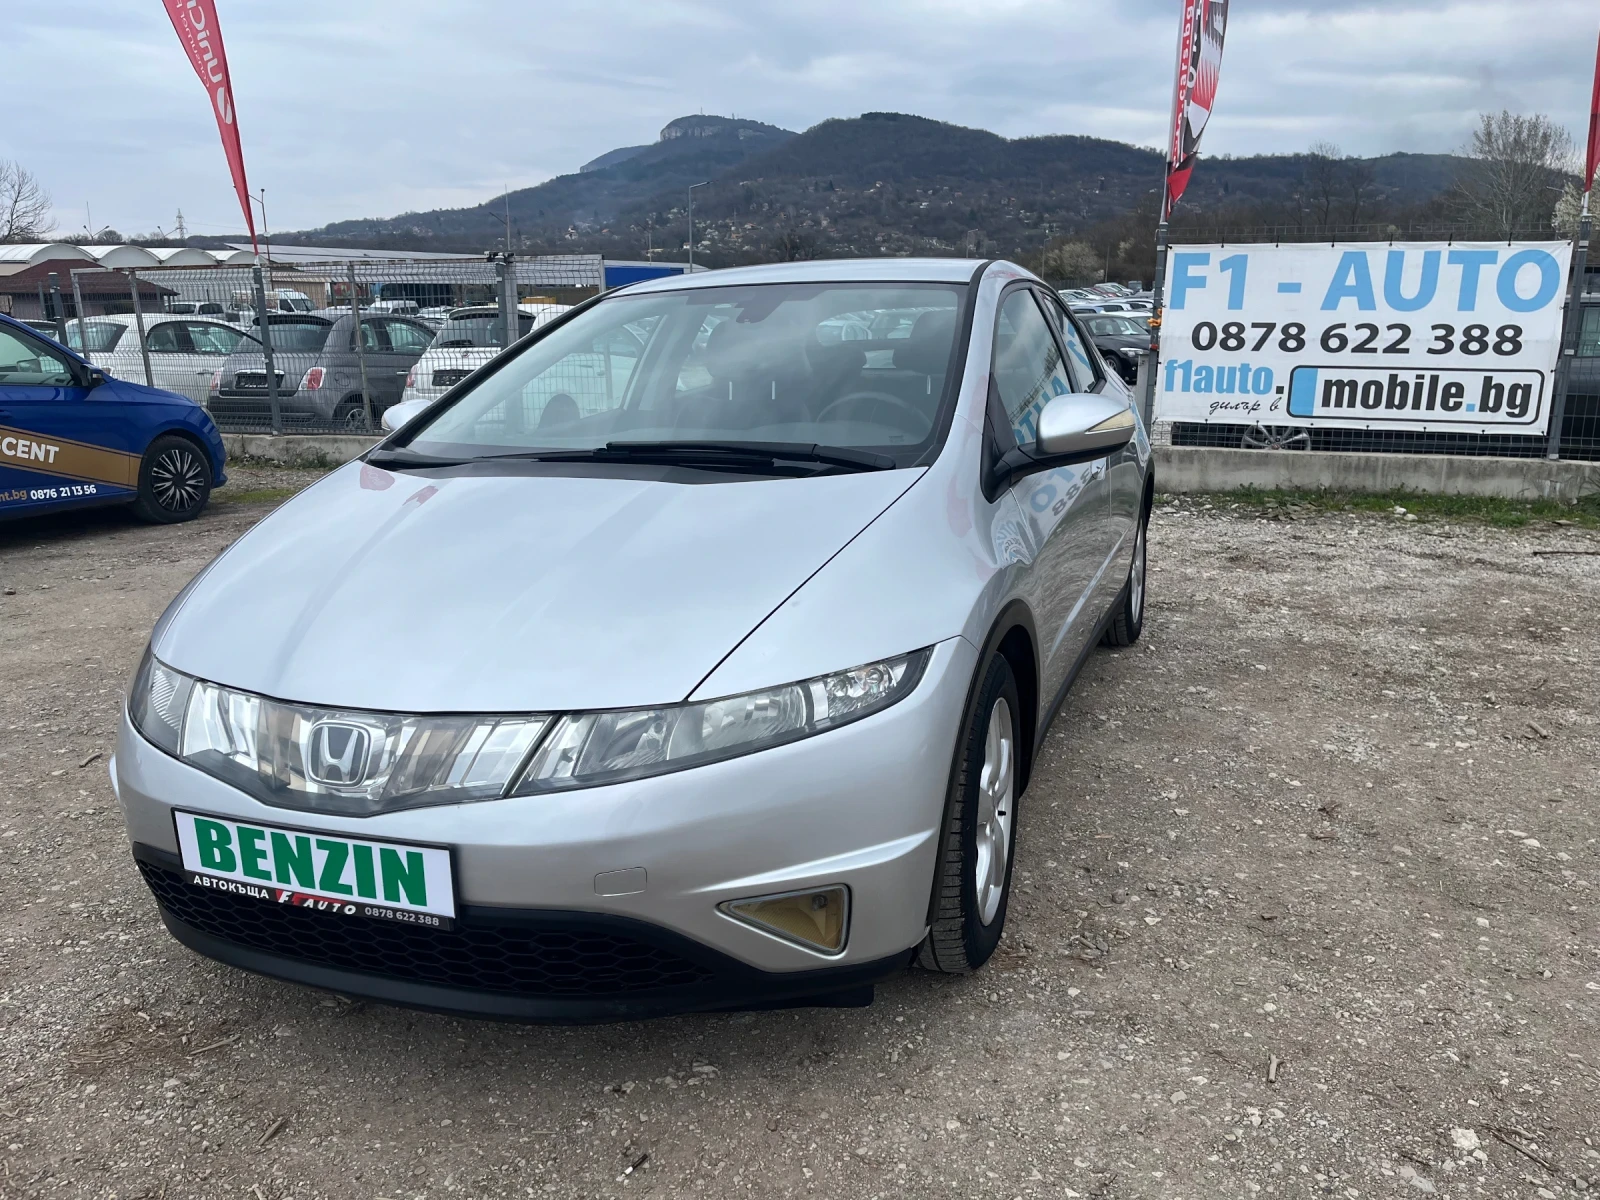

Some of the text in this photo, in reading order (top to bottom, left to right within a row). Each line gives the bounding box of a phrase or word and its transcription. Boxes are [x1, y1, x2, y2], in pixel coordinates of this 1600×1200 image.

[1169, 252, 1248, 310] F1
[1320, 249, 1560, 313] AUTO
[1191, 320, 1523, 356] 0878 622 388
[1321, 373, 1532, 418] mobile.bg
[0, 436, 60, 464] CENT
[30, 488, 57, 500] 0876
[59, 487, 71, 497] 21
[72, 485, 83, 496] 13
[83, 484, 96, 495] 56
[193, 817, 428, 907] BENZIN
[194, 874, 269, 900] АВТОКЪЩА
[303, 898, 357, 915] AUTO
[364, 906, 394, 919] 0878
[395, 911, 416, 922] 622
[417, 914, 440, 926] 388
